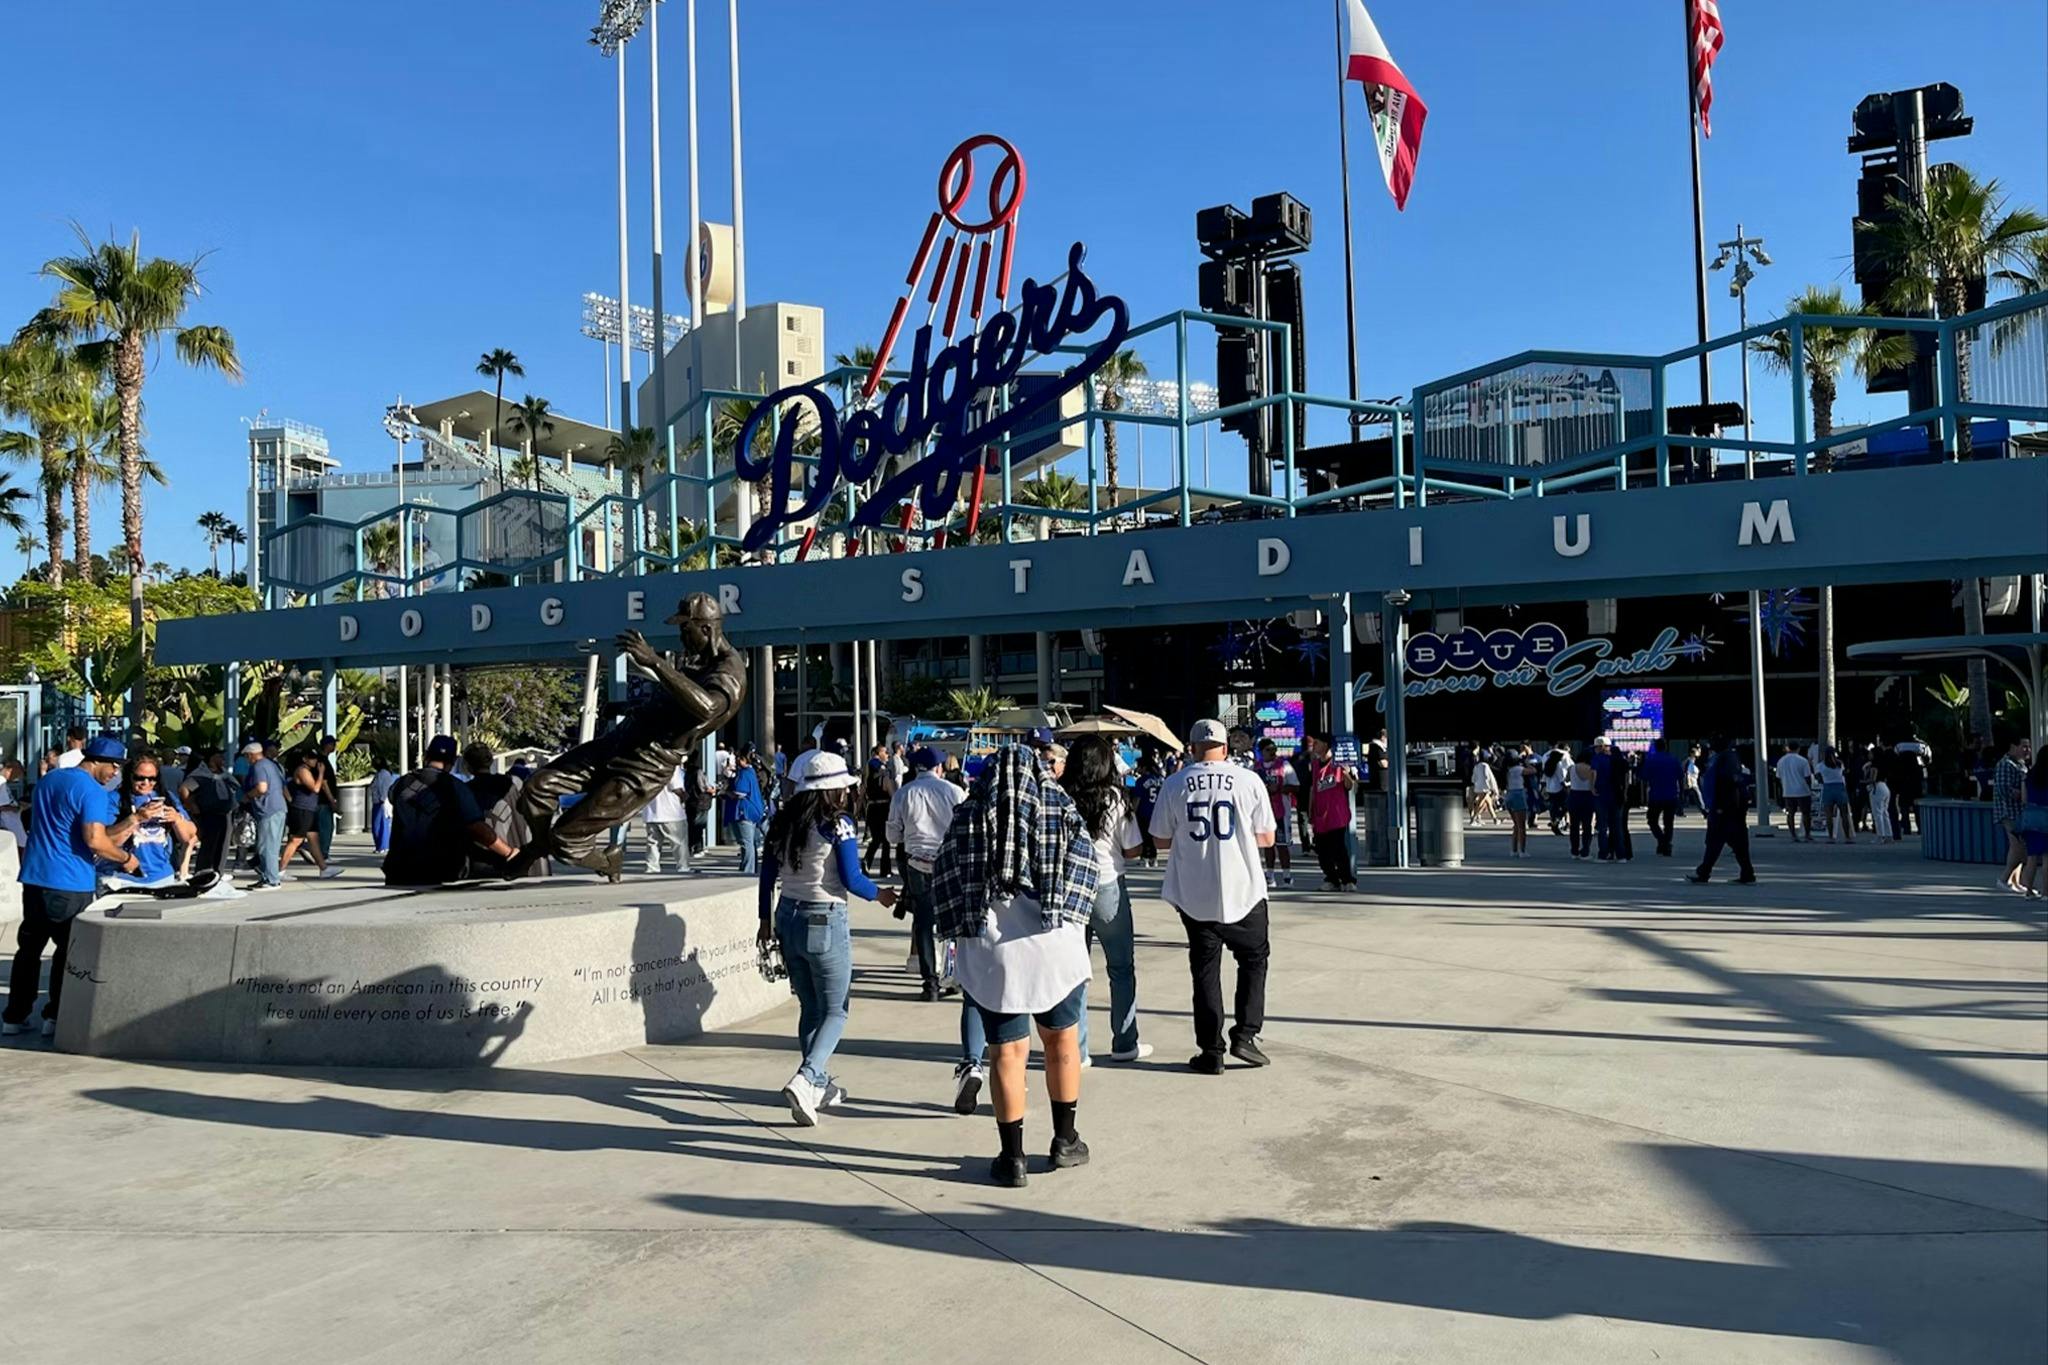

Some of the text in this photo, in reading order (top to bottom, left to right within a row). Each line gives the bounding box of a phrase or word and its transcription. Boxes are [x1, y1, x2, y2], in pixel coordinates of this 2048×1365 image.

[735, 241, 1130, 552] Dodgers
[1471, 387, 1614, 429] ULTRA
[340, 499, 1796, 642] DODGER STADIUM
[1414, 637, 1554, 662] BLUE
[1353, 627, 1682, 712] Haven on Earth
[1186, 773, 1234, 793] BETTS
[835, 818, 855, 841] LA
[1187, 800, 1235, 842] 50
[607, 965, 626, 978] not
[629, 951, 687, 974] concerned
[300, 981, 323, 994] not
[327, 983, 345, 994] an
[351, 980, 423, 994] American
[430, 980, 444, 994] in
[449, 977, 477, 993] this
[480, 976, 543, 992] country
[592, 987, 610, 1005] All
[613, 987, 616, 1002] I
[621, 982, 640, 1000] ask
[643, 983, 651, 995] is
[655, 978, 675, 992] that
[677, 977, 695, 992] you
[265, 1002, 294, 1019] free
[299, 1004, 330, 1020] until
[334, 1008, 376, 1024] every
[380, 1010, 410, 1021] one
[416, 1003, 434, 1020] of
[437, 1008, 454, 1020] us
[460, 1004, 471, 1019] is
